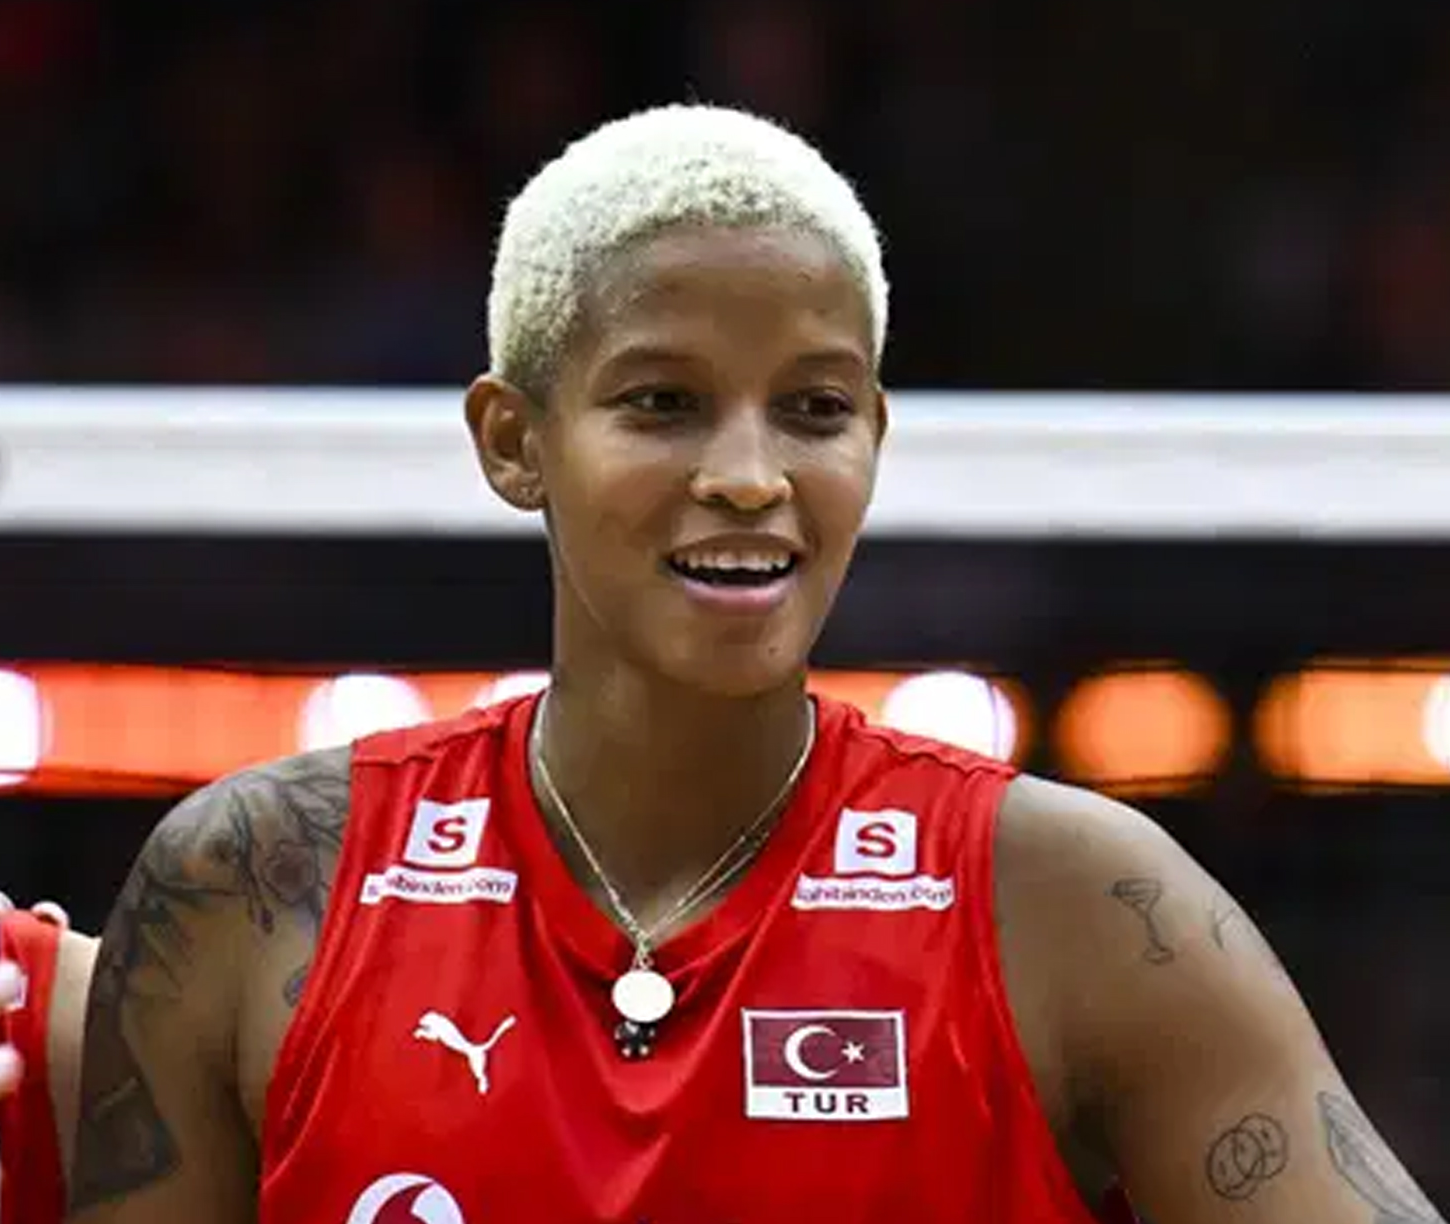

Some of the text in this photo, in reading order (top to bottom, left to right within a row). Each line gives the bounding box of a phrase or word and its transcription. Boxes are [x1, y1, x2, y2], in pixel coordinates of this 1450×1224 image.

[427, 815, 467, 854] S
[856, 822, 897, 858] S
[786, 1091, 870, 1115] TUR
